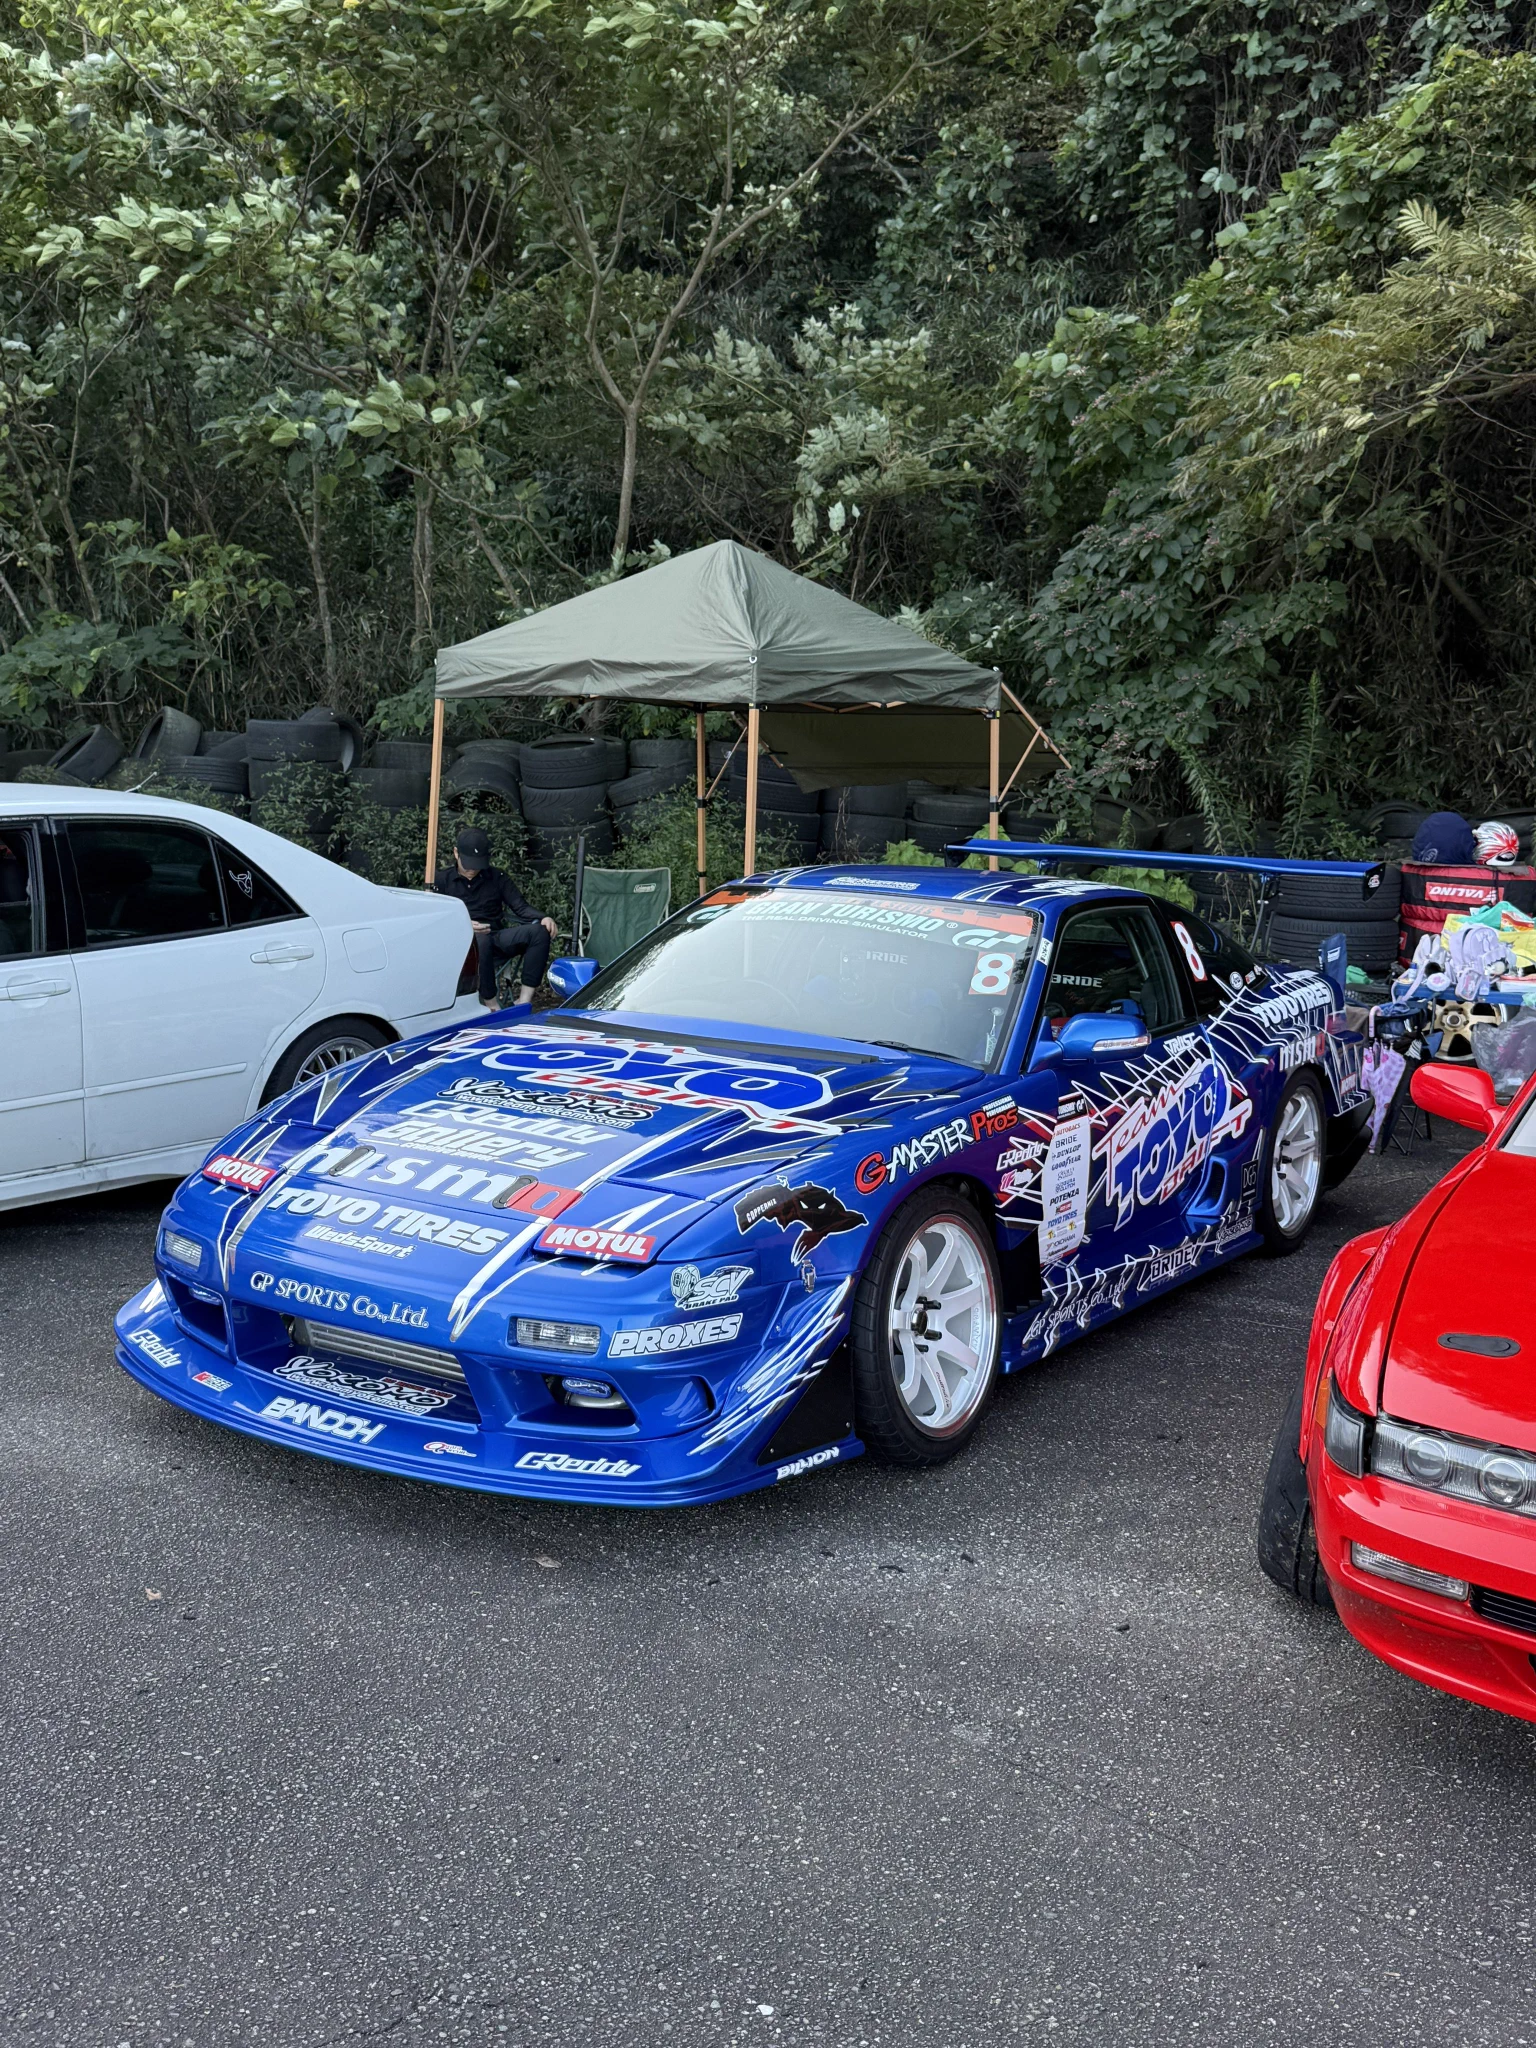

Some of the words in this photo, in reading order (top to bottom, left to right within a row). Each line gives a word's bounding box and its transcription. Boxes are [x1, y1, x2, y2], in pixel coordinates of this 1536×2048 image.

[745, 901, 820, 916] GRAN
[1428, 885, 1485, 899] VALINO
[798, 916, 849, 925] DRIVING
[852, 920, 929, 939] SIMULATOR
[1175, 923, 1206, 981] 8
[970, 953, 1014, 994] 8
[1051, 973, 1103, 988] BRIDE
[1251, 993, 1295, 1028] TOYO
[1290, 981, 1332, 1017] TIRES
[1163, 1032, 1196, 1055] TRUST
[445, 1034, 832, 1115] TOYO
[397, 1100, 618, 1145] GReddy
[455, 1093, 635, 1128] www.teamyokomo.com
[971, 1108, 1018, 1142] Pros
[370, 1119, 591, 1169] Gallery
[996, 1141, 1044, 1171] GReddy
[1055, 1134, 1078, 1149] BRIDE
[1056, 1144, 1082, 1159] DUNLOP
[1114, 1062, 1228, 1224] TOYO
[207, 1157, 265, 1186] MOTUL
[1049, 1188, 1080, 1206] POTENZA
[267, 1187, 384, 1224] TOYO
[376, 1205, 511, 1257] TIRES
[1047, 1214, 1062, 1228] TOYO
[1062, 1209, 1078, 1221] TIRES
[545, 1226, 648, 1256] MOTUL
[1151, 1245, 1193, 1281] BRIDE
[250, 1270, 275, 1293] GP
[274, 1276, 350, 1312] SPORTS
[688, 1269, 751, 1302] SCV
[1047, 1297, 1088, 1329] SPORTS
[127, 1329, 182, 1368] GReddy
[612, 1315, 742, 1357] PROXES
[288, 1373, 431, 1415] www.teamyokomo.com
[259, 1395, 387, 1444] BANDOH
[514, 1451, 642, 1478] GReddy
[776, 1447, 839, 1480] BILLION
